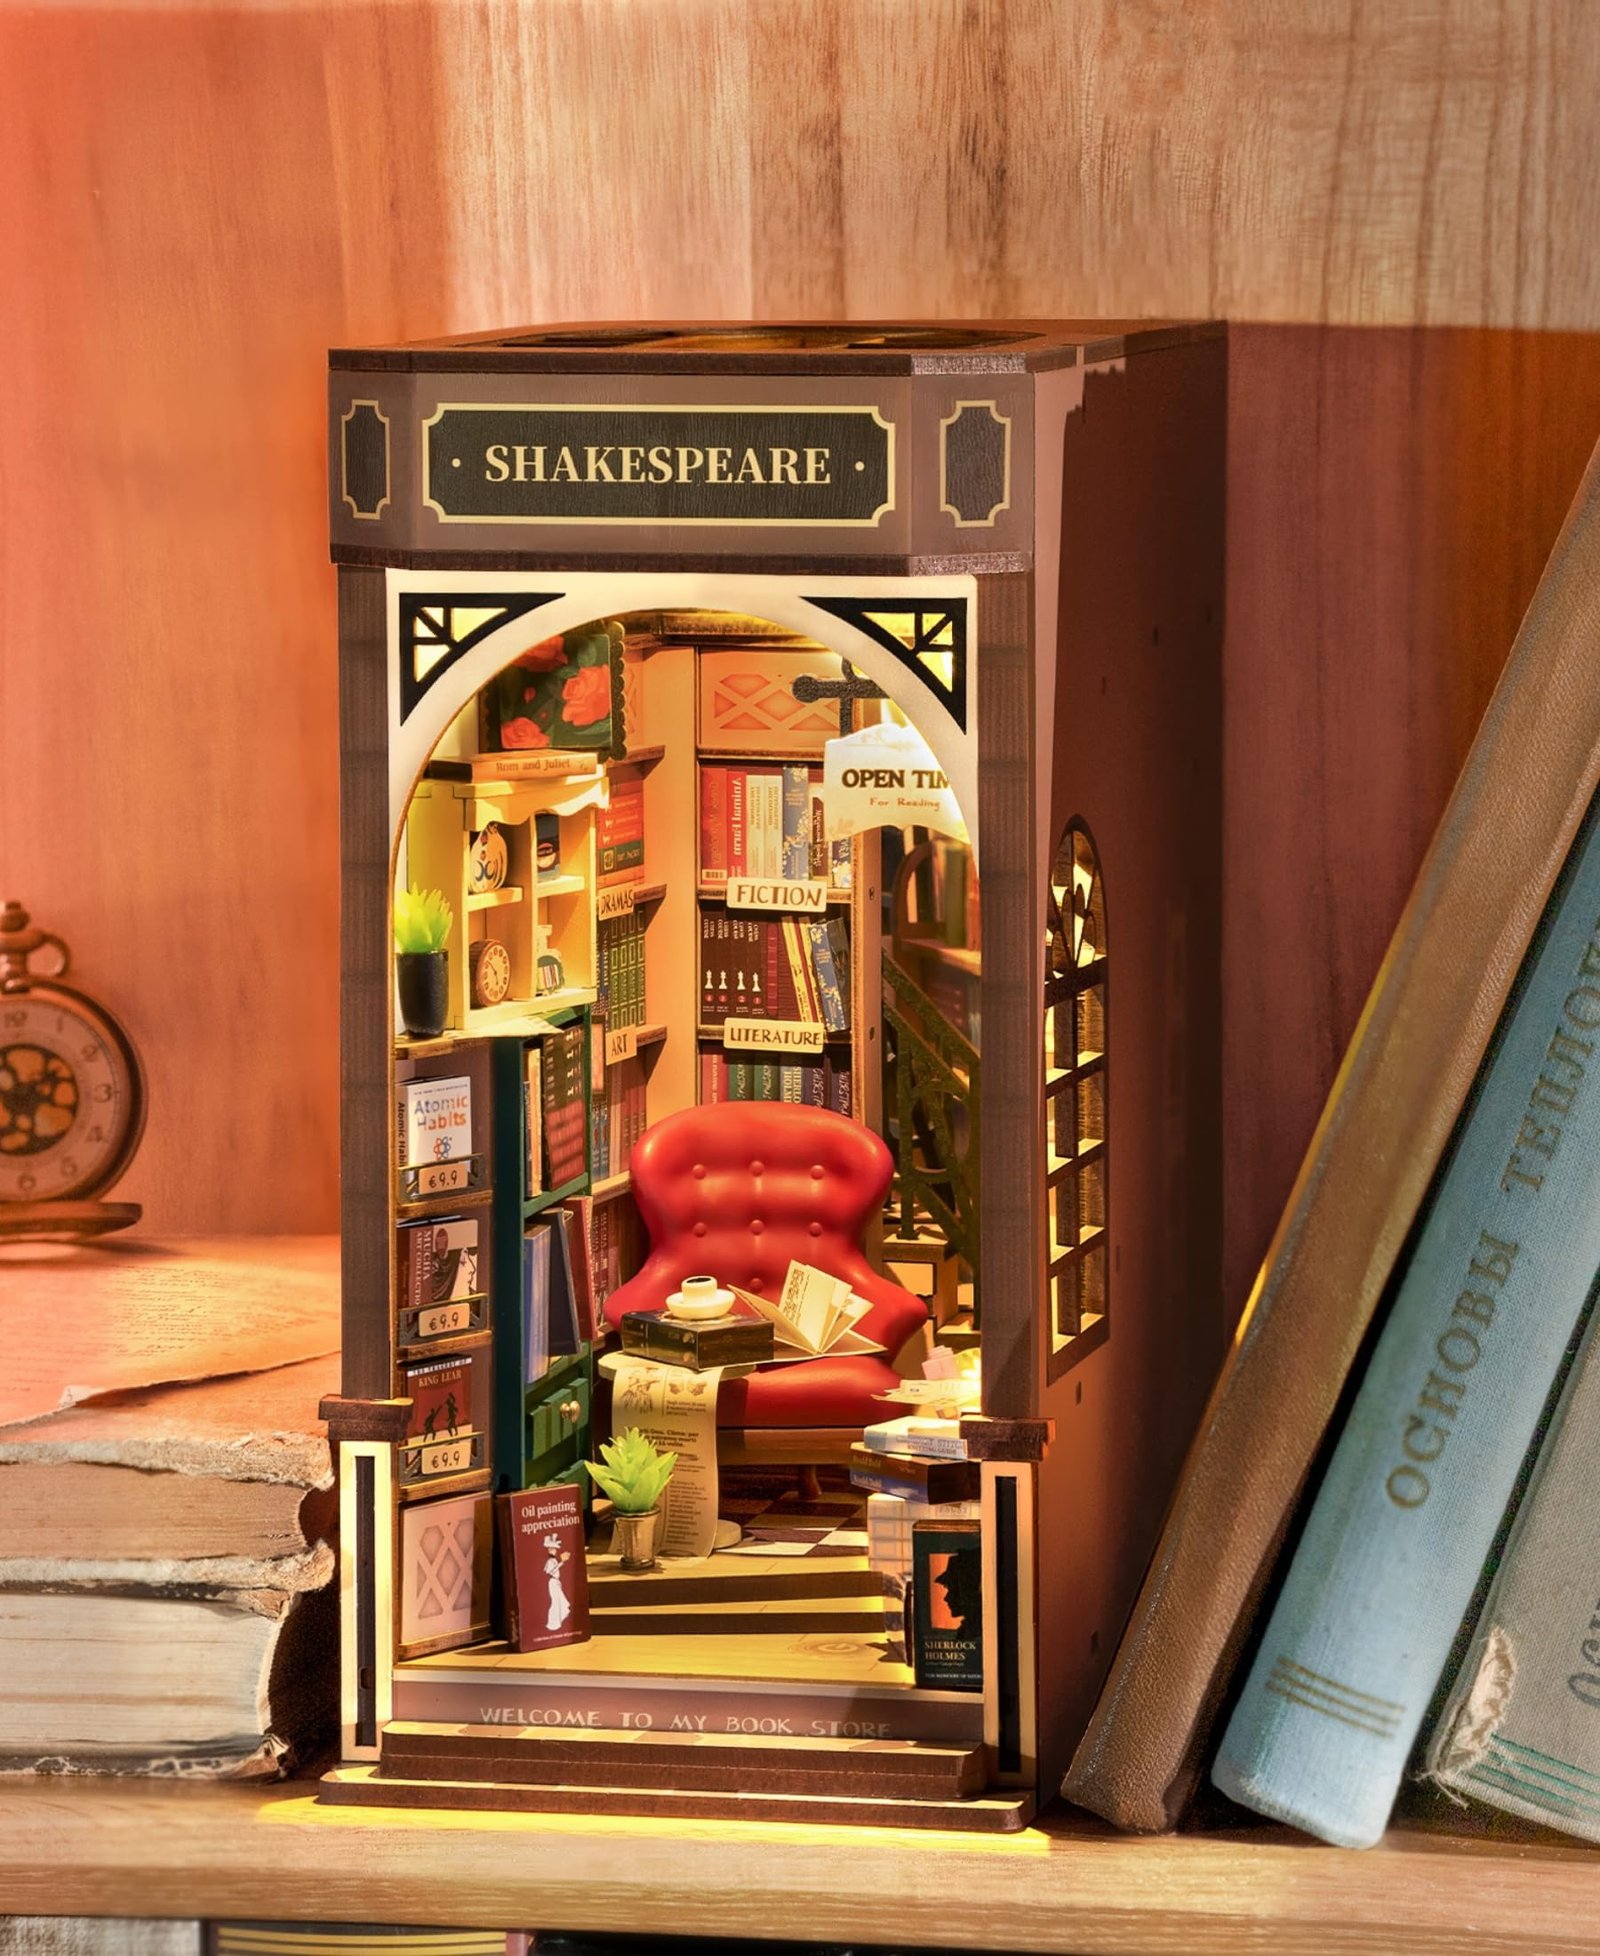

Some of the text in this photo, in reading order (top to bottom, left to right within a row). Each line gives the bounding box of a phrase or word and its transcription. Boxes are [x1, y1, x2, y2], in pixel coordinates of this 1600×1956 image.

[485, 444, 831, 484] SHAKESPEARE
[523, 759, 540, 771] and
[544, 758, 571, 771] Juliet
[842, 768, 905, 788] OPEN
[870, 797, 940, 811] For Reading
[601, 889, 634, 915] DRAMAS
[737, 884, 822, 906] FICTION
[611, 1033, 628, 1057] ART
[730, 1027, 823, 1046] LITERATURE
[415, 1095, 469, 1116] Atomic
[398, 1102, 406, 1138] Atomic
[417, 1112, 466, 1131] Habits
[428, 1170, 458, 1189] €9.9
[1386, 915, 1600, 1510] ОСНОВЫ ТЕПЛО
[423, 1230, 431, 1280] MUCHA
[429, 1311, 459, 1331] €9.9
[418, 1369, 462, 1388] KING LEAR
[431, 1451, 460, 1469] €9.9
[521, 1502, 576, 1519] Oil painting
[521, 1515, 580, 1535] appreciation
[924, 1640, 976, 1650] SHERLOCK
[925, 1651, 966, 1661] HOLMES
[480, 1707, 891, 1739] WELCOME TO MY BOOK STORE
